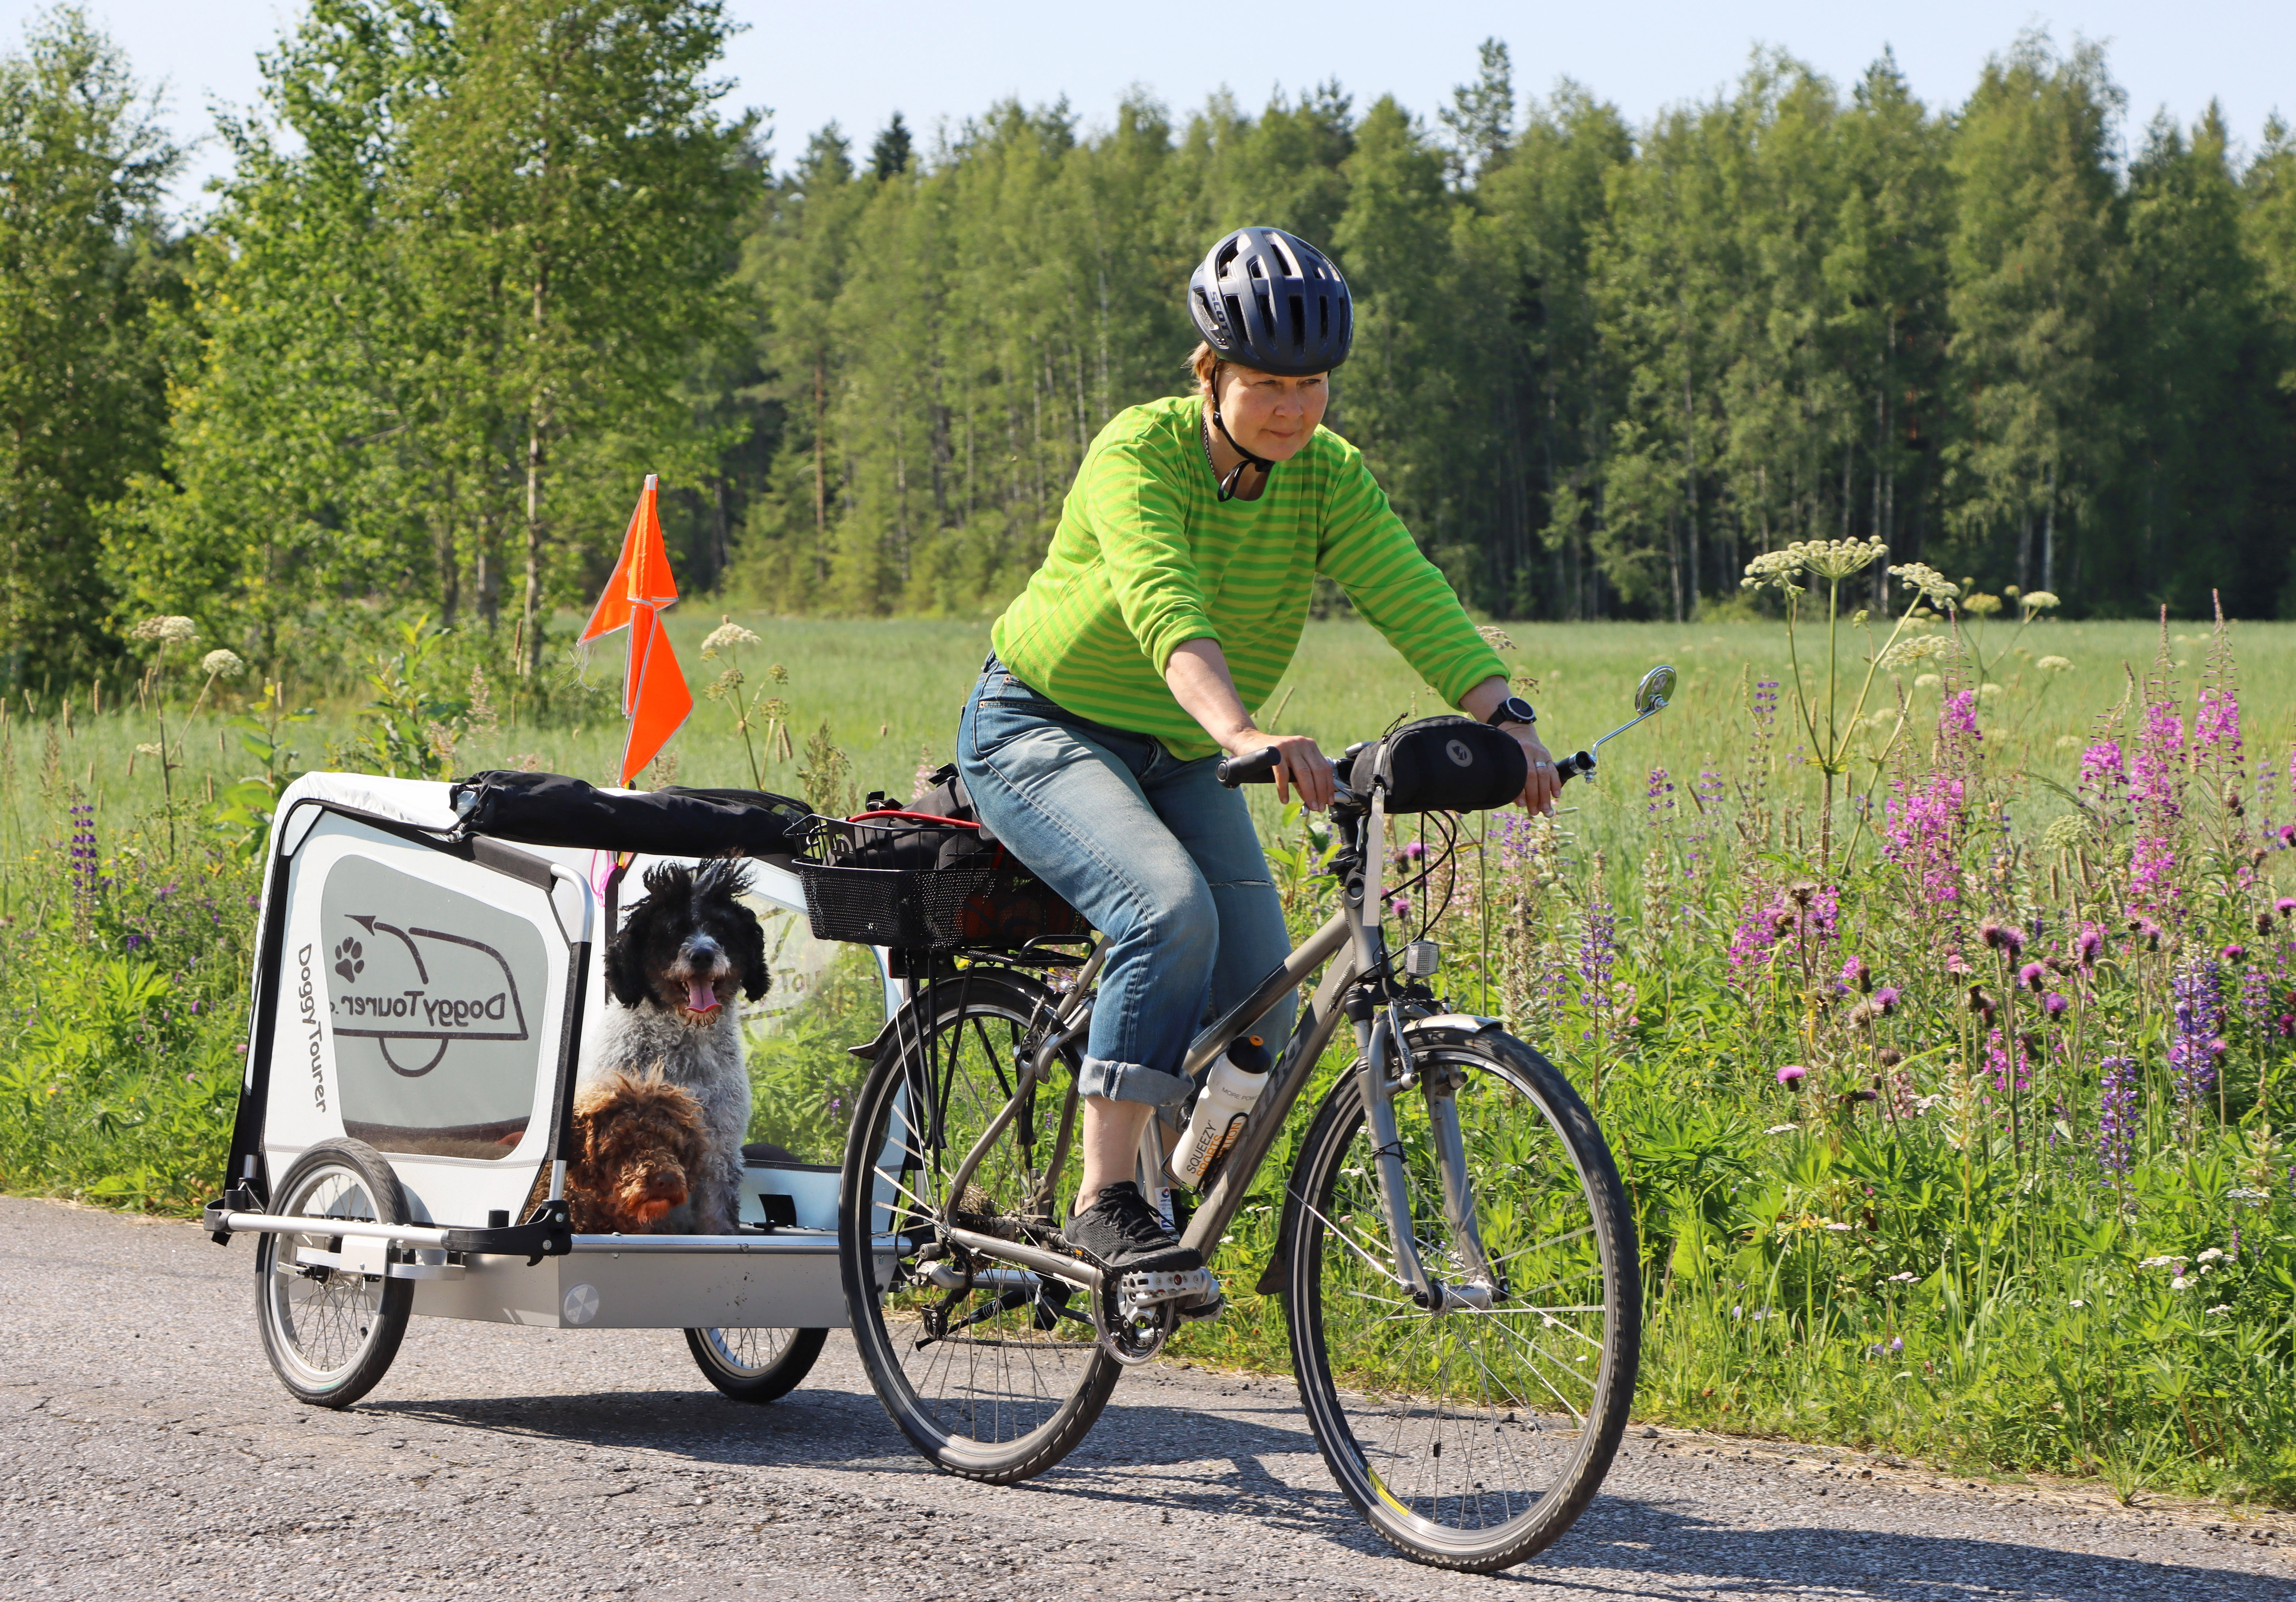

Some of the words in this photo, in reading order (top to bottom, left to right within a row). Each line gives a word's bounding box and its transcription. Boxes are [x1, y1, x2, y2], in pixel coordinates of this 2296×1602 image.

[1210, 291, 1234, 342] SCOTT
[297, 943, 326, 1113] DoggyTourer
[1222, 1086, 1240, 1100] MORE
